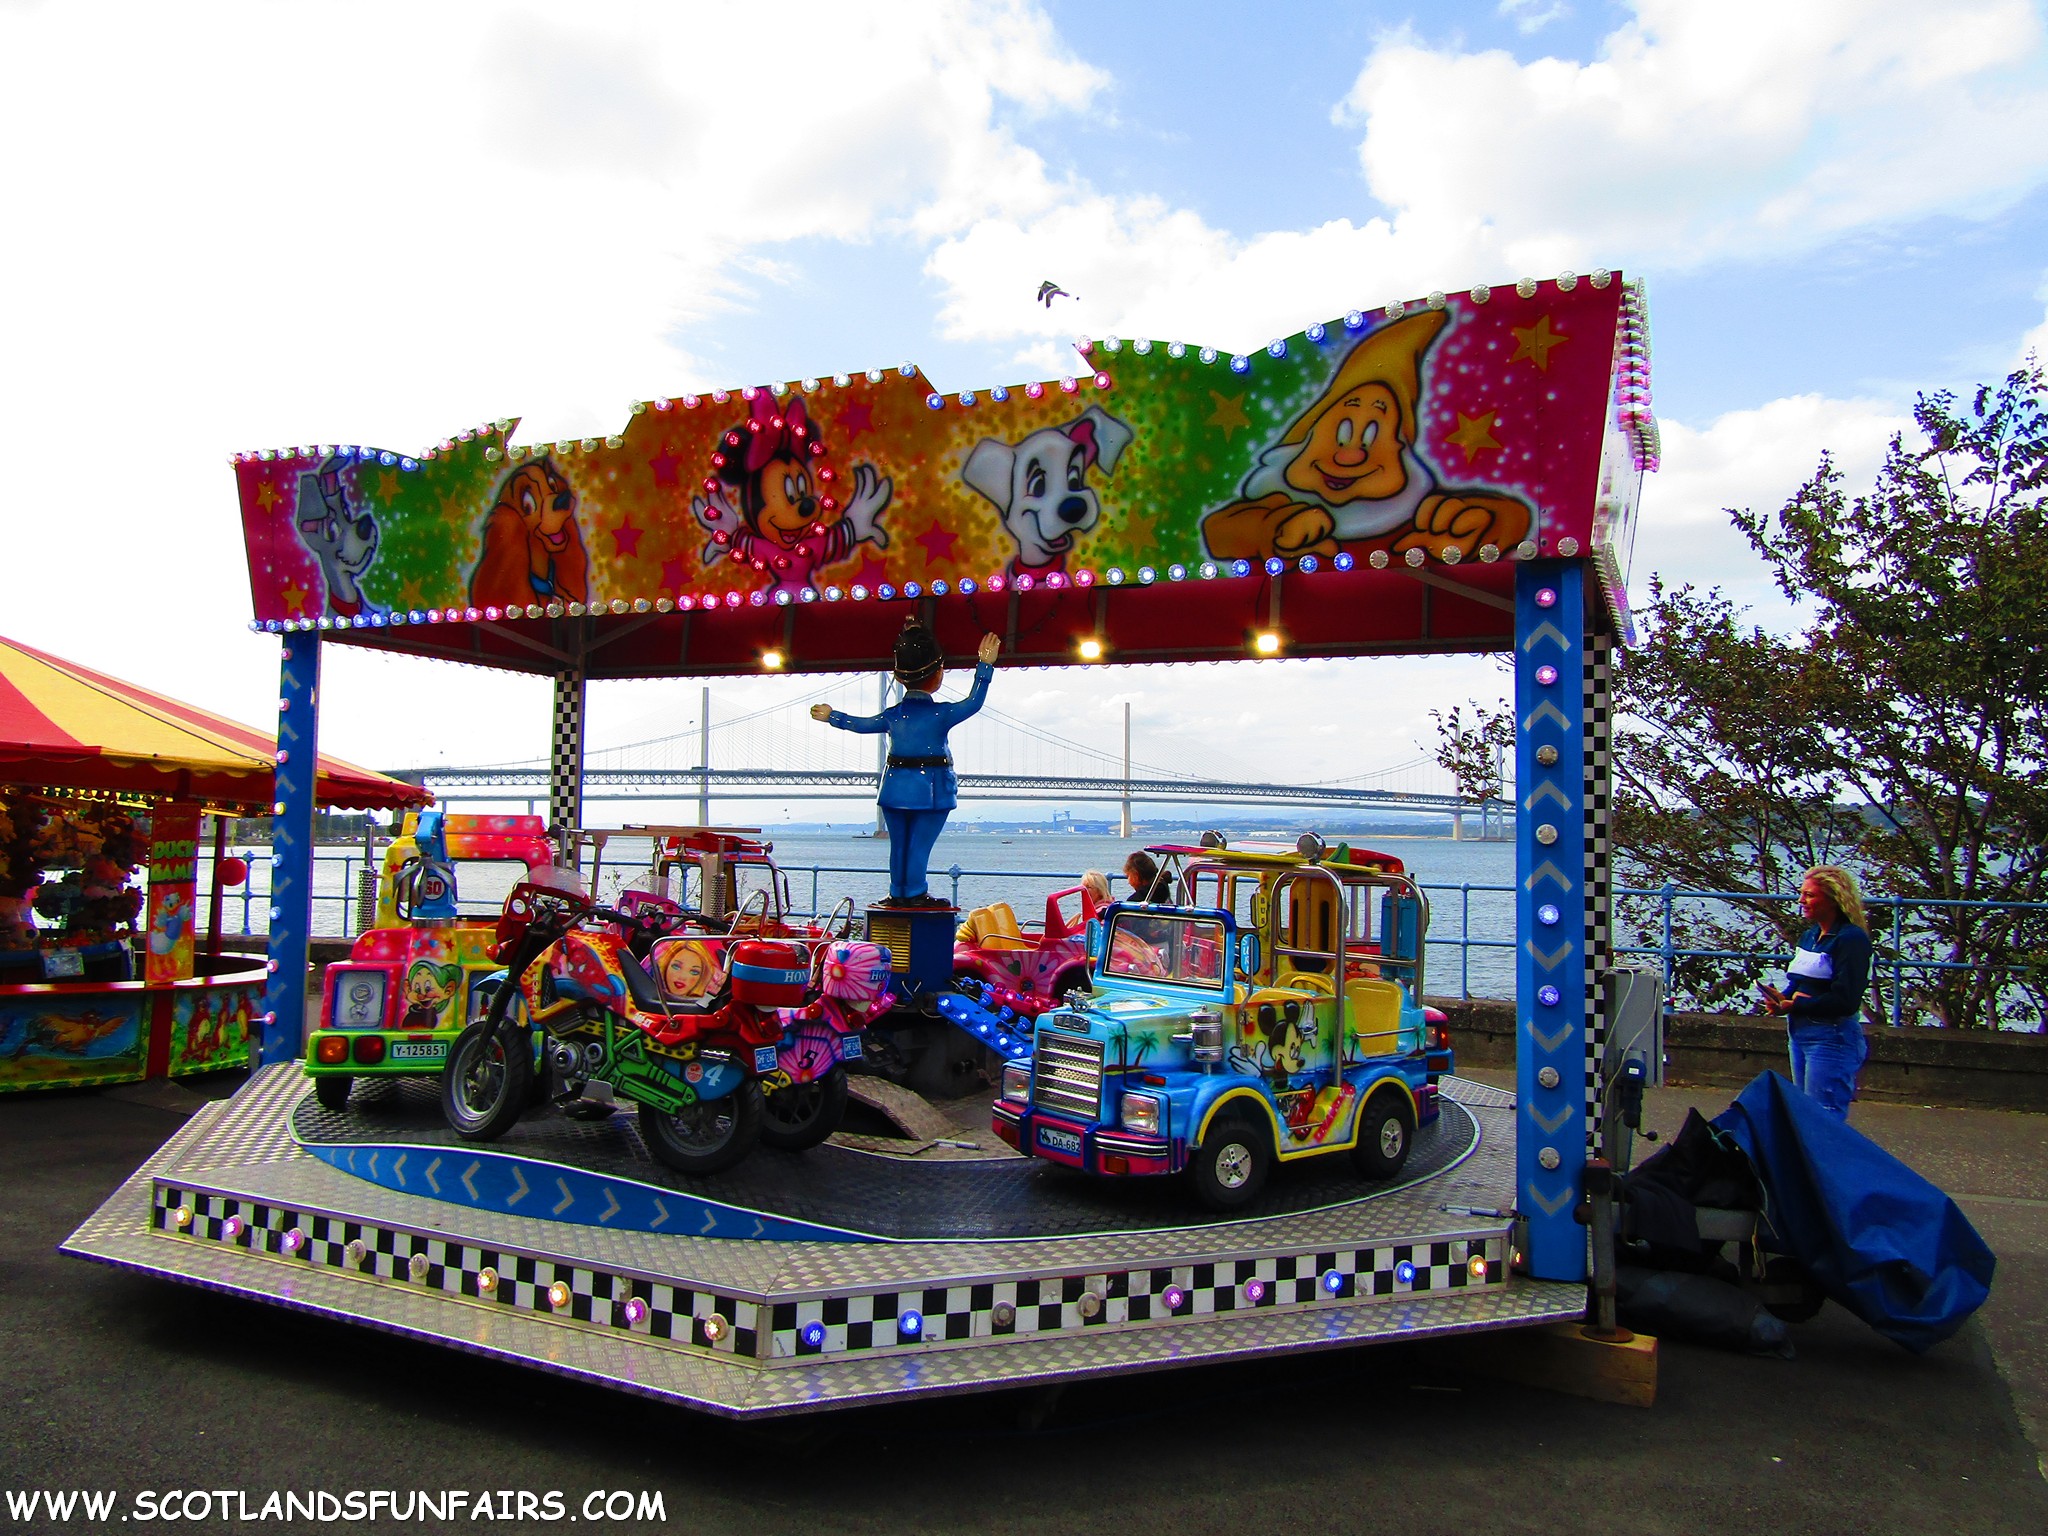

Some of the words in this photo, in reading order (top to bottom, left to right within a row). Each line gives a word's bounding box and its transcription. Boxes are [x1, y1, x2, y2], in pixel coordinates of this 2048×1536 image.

[154, 840, 196, 859] DUCK
[396, 1045, 445, 1056] Y-125851
[705, 1064, 725, 1086] 4
